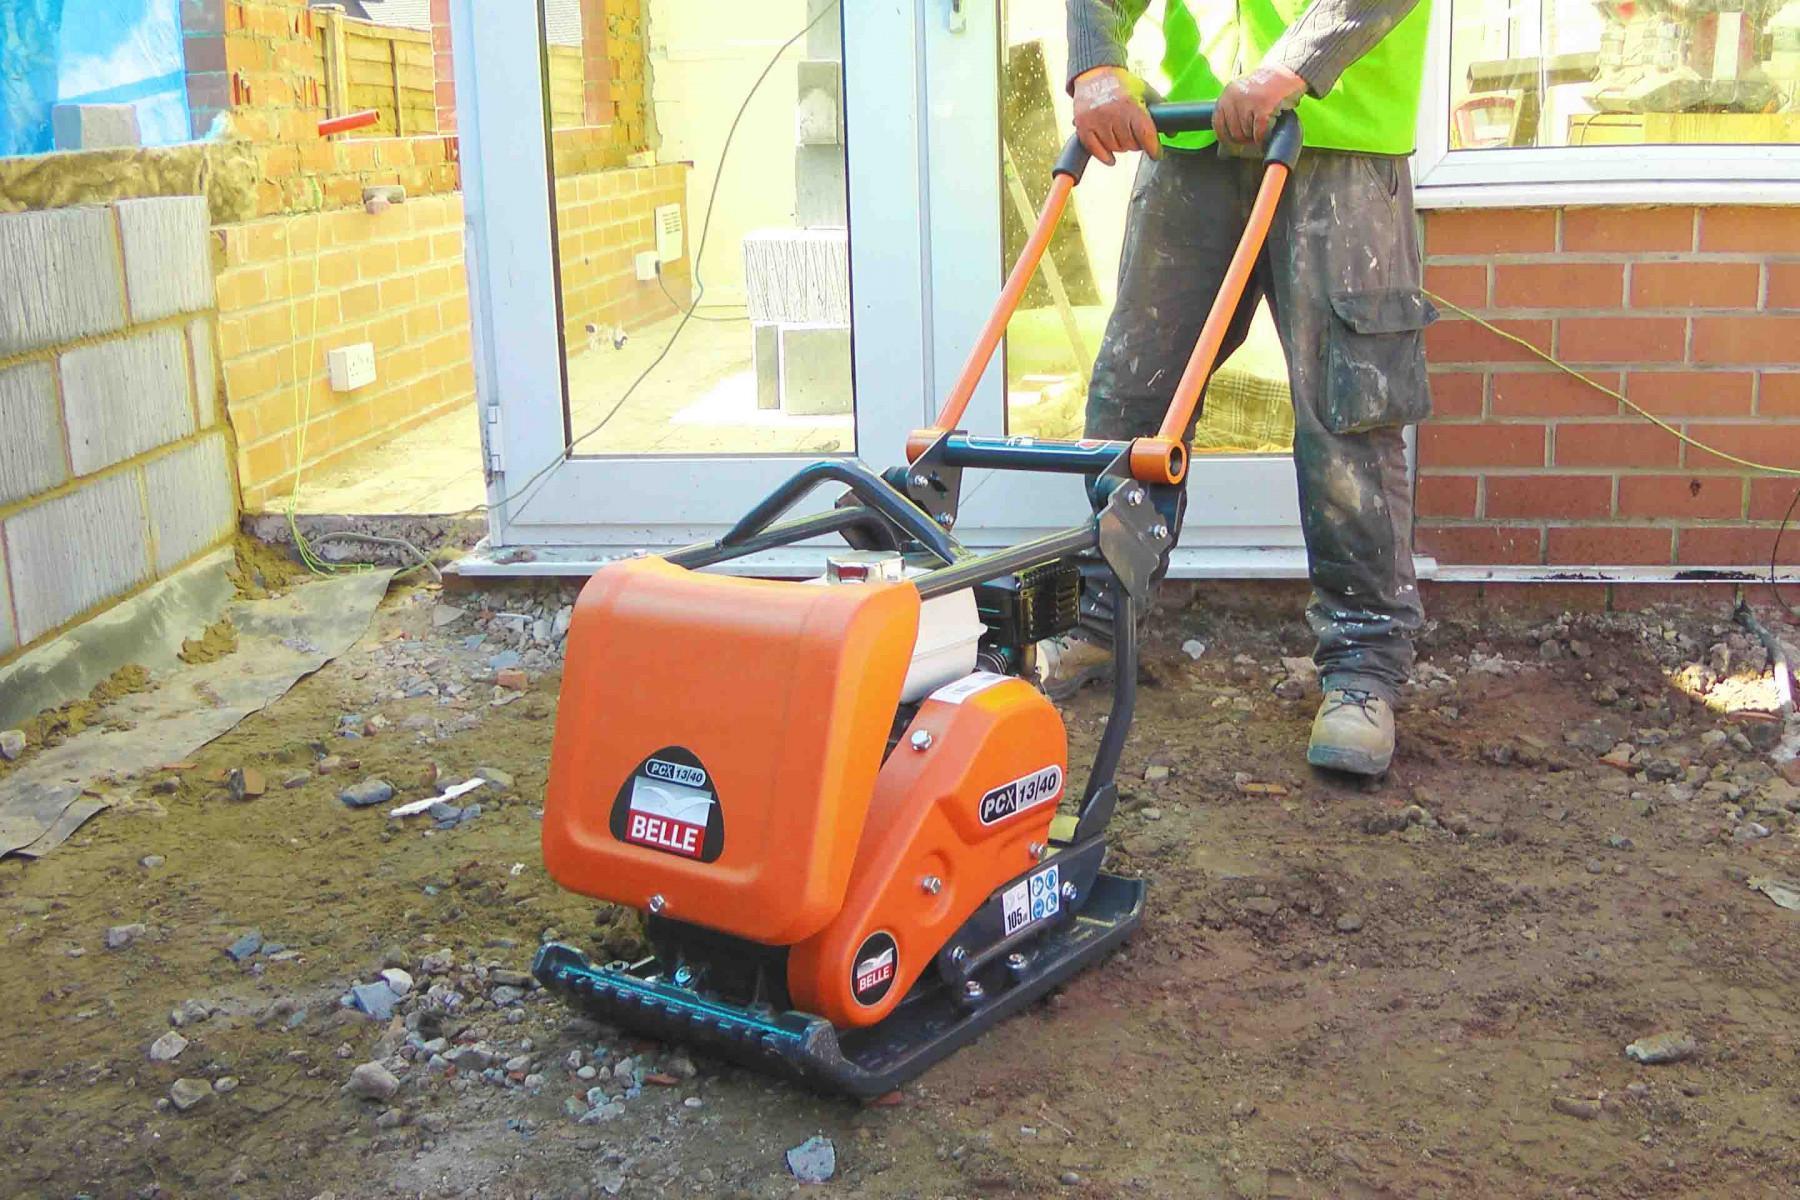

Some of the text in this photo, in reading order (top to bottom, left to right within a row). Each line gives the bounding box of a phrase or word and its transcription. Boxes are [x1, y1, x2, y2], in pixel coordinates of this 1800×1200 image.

[651, 762, 703, 783] PCX 13/40
[983, 772, 1057, 819] PCX 13/40
[631, 814, 699, 852] BELLE
[1007, 907, 1023, 931] 105
[859, 966, 890, 992] BELLE
